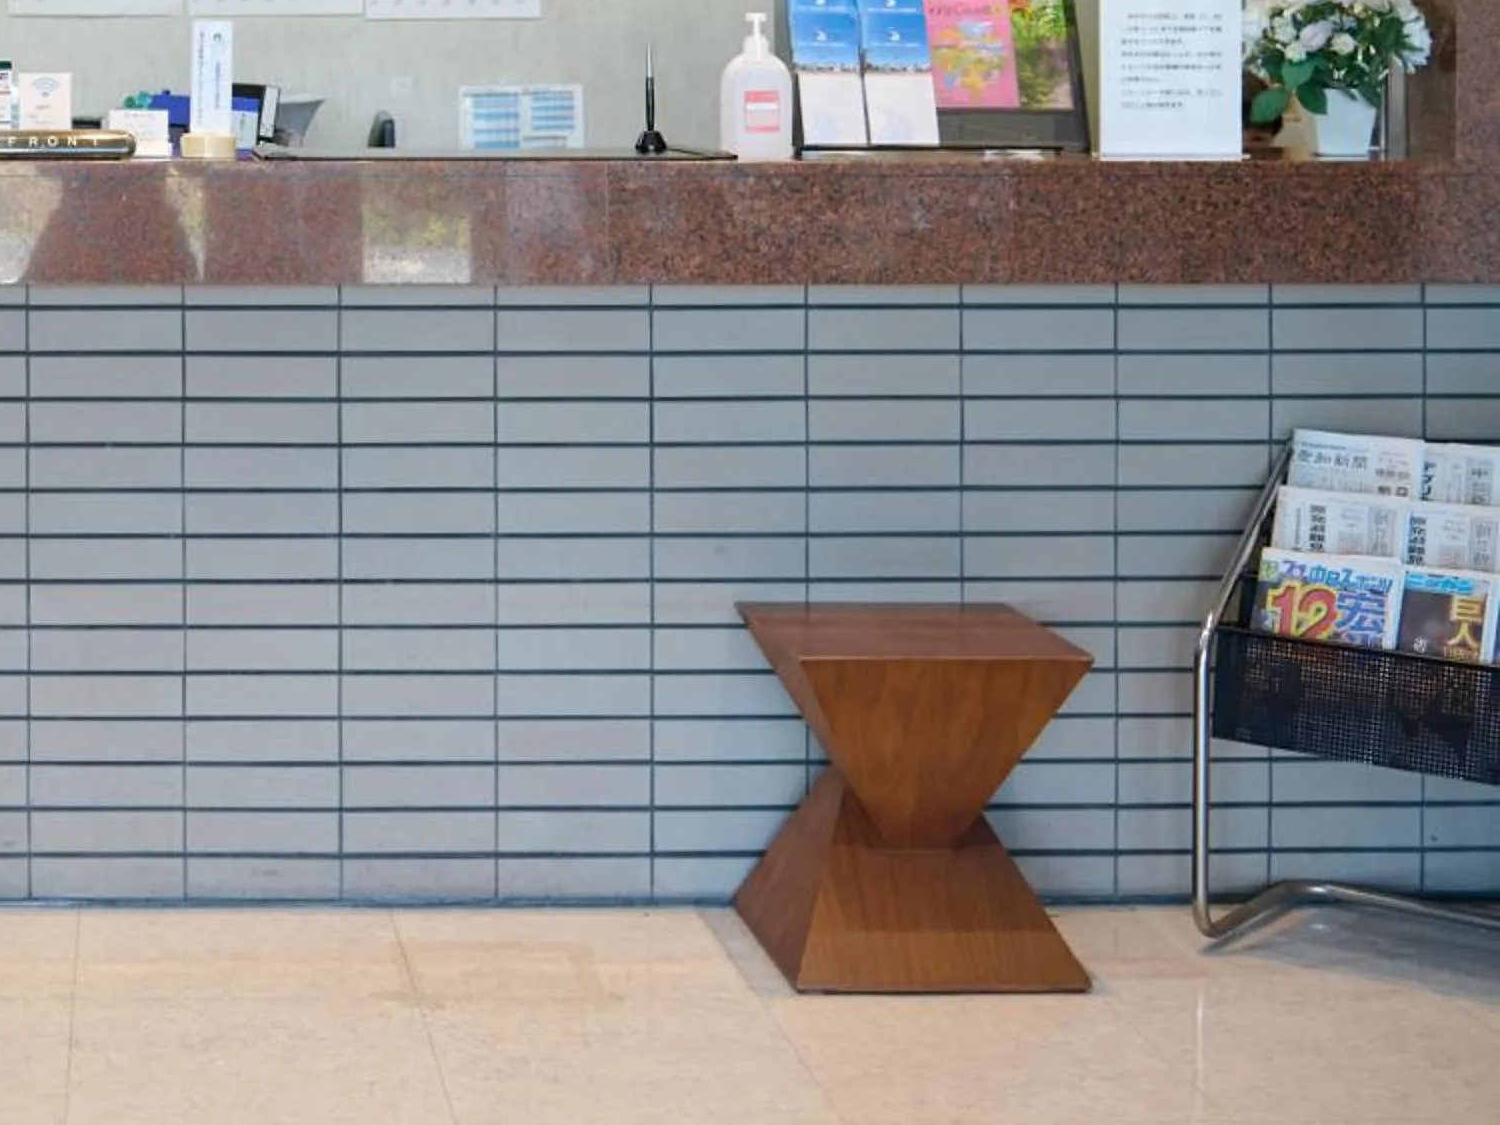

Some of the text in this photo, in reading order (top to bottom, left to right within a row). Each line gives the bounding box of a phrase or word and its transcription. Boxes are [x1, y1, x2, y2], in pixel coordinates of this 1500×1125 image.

[7, 136, 100, 148] FRONT
[1272, 584, 1338, 638] 12
[1447, 595, 1485, 650] 巨人
